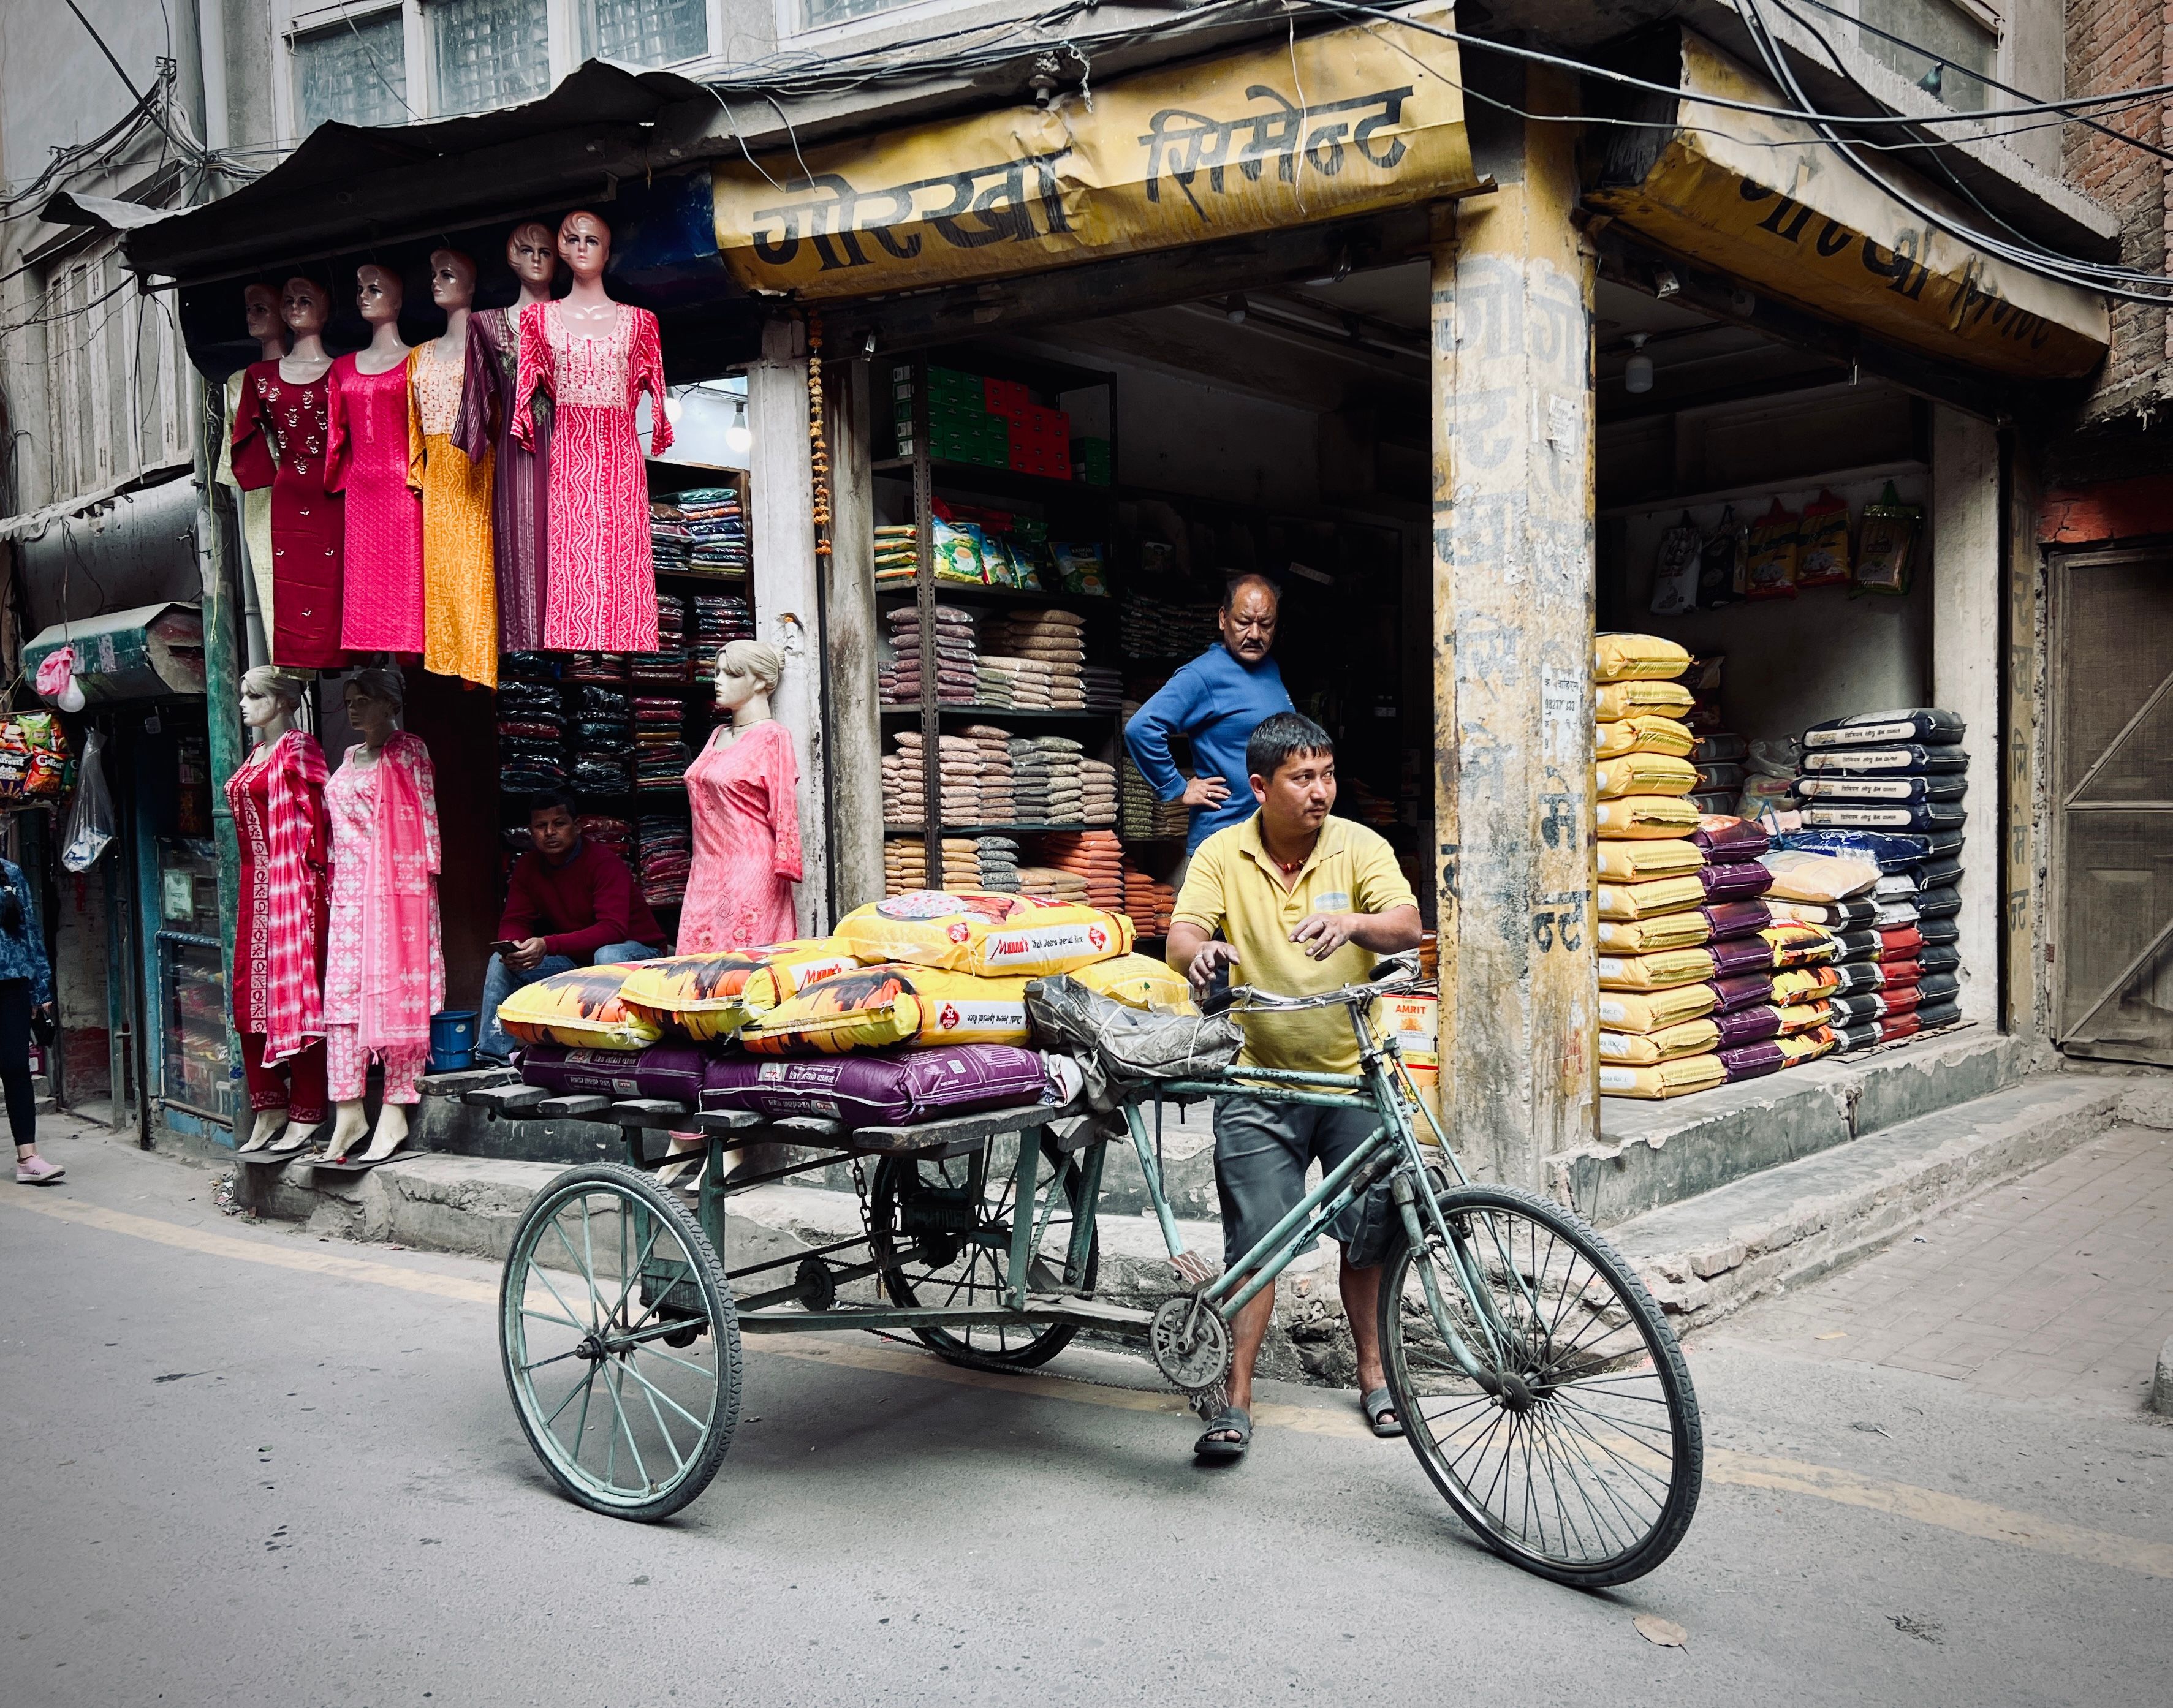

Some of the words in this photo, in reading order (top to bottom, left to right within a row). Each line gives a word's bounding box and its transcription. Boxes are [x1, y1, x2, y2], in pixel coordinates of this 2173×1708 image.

[752, 146, 1076, 271] गोरखा
[1138, 84, 1413, 223] सिमेन्ट
[1395, 1005, 1427, 1015] AMRIT
